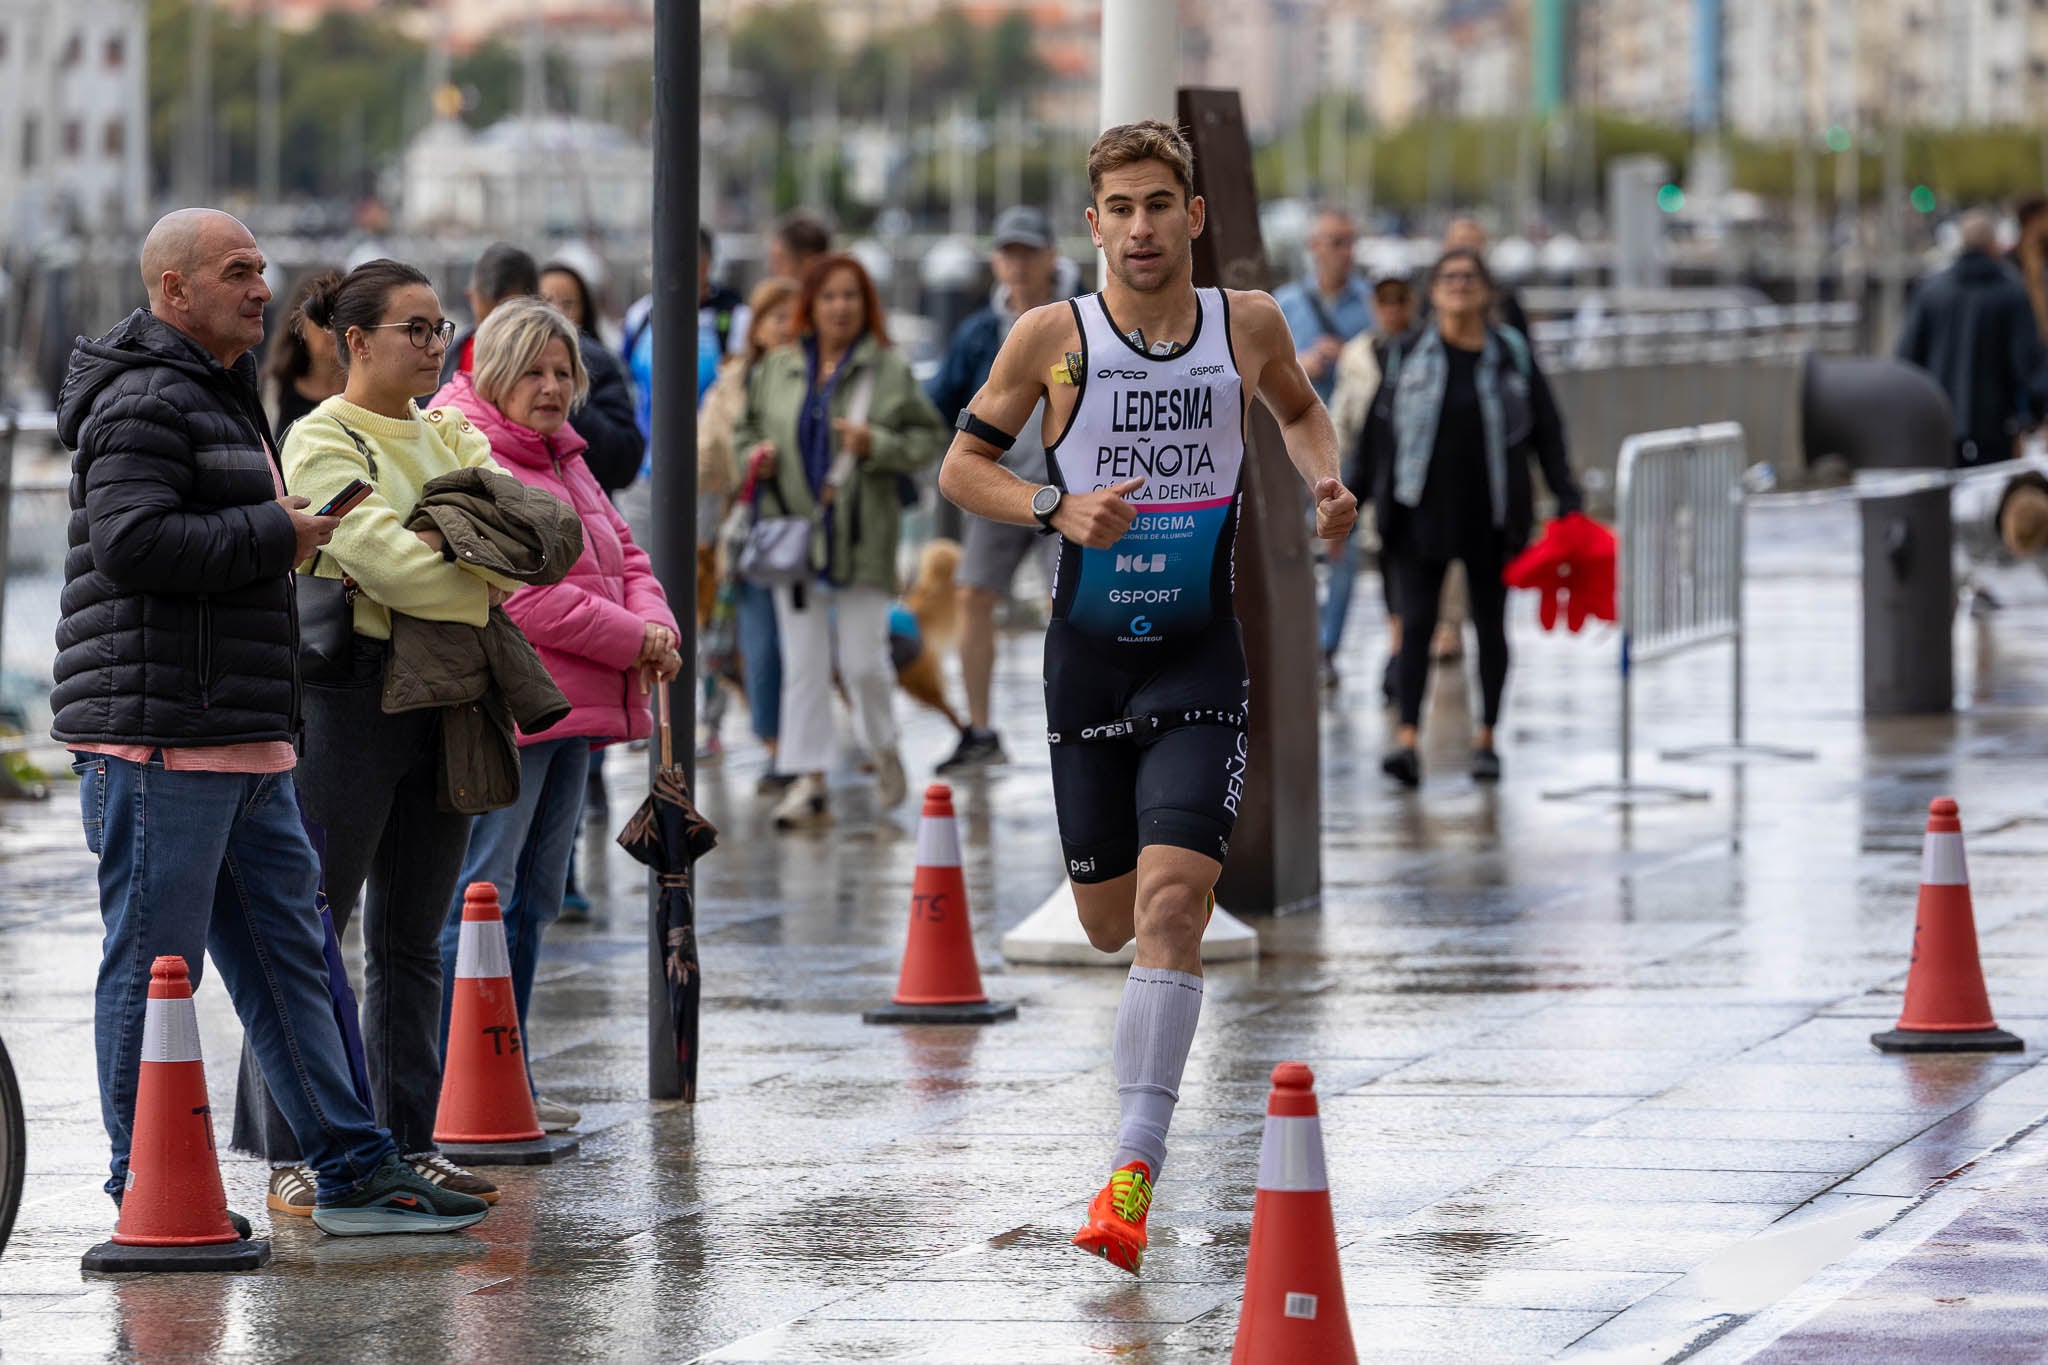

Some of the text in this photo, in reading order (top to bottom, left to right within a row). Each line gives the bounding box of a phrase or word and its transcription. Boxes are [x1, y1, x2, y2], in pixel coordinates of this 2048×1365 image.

[1097, 369, 1148, 380] orca
[1190, 365, 1225, 377] GSPORT
[1112, 386, 1213, 433] LEDESMA
[1096, 437, 1215, 478] PEÑOTA
[1158, 481, 1217, 500] DENTAL
[1129, 515, 1196, 531] USIGMA
[1109, 588, 1183, 603] GSPORT
[1117, 635, 1163, 643] GALLASTEGUI
[913, 894, 948, 923] TS
[482, 1026, 521, 1056] TS
